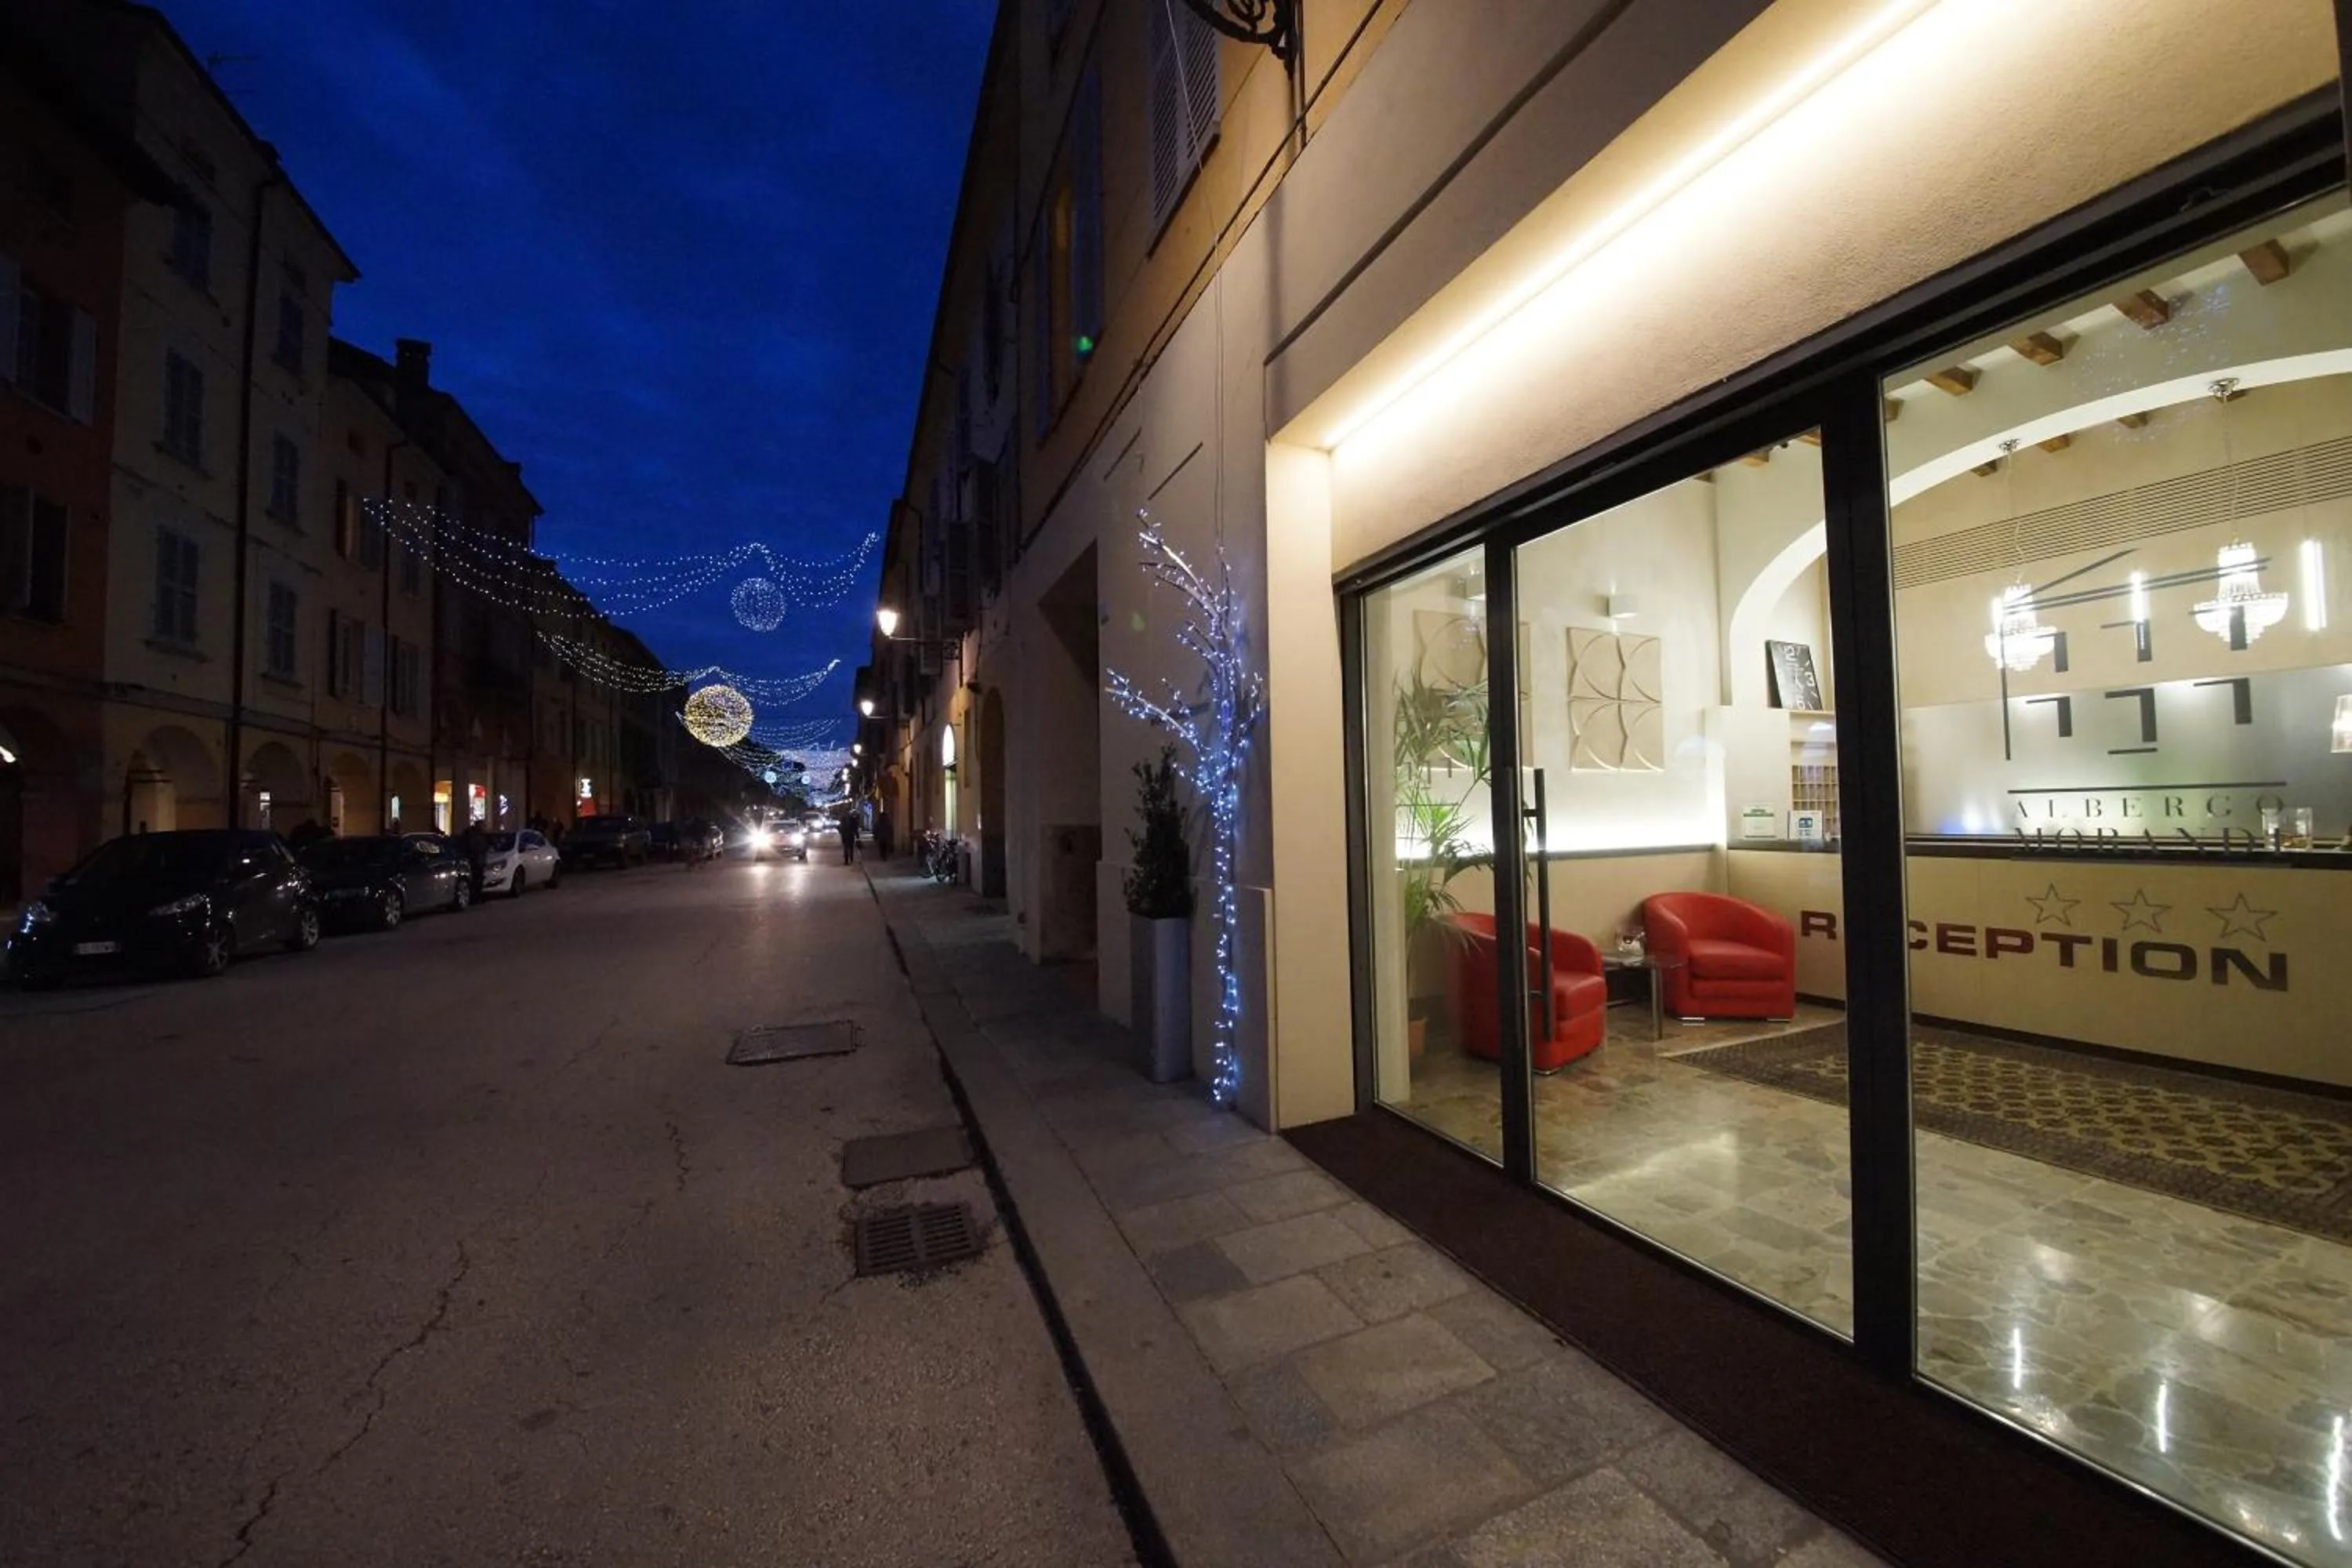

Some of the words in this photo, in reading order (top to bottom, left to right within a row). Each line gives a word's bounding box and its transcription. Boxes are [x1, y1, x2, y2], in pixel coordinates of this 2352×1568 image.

[1804, 672, 1815, 686] 3
[2015, 793, 2285, 818] ALBERGO
[2013, 826, 2281, 855] MORANDI
[1800, 909, 2288, 993] RCEPTION
